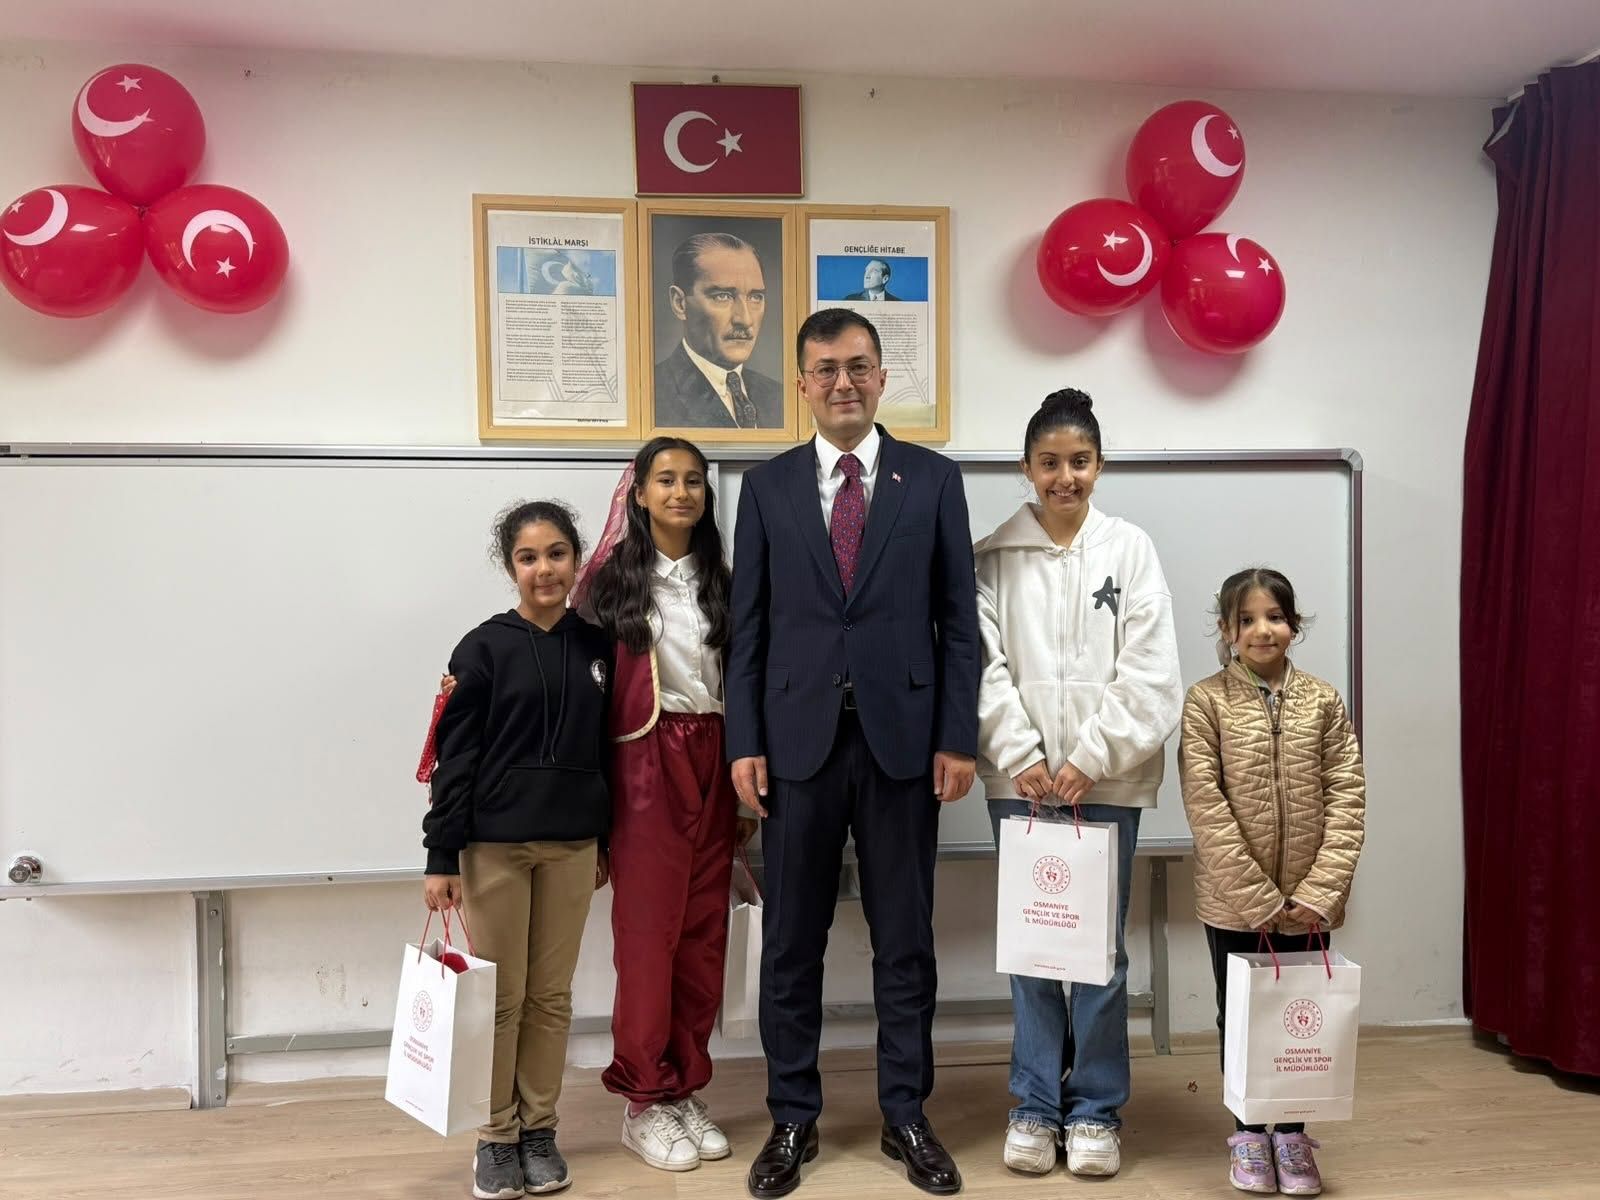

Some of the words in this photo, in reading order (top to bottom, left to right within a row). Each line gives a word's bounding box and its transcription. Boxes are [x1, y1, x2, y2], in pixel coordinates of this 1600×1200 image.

[844, 245, 879, 254] GENÇLİĞE
[880, 245, 905, 254] HİTABE
[1033, 901, 1069, 911] OSMANİYE
[1022, 909, 1050, 917] GENÇLİK
[1051, 911, 1060, 919] VE
[1061, 913, 1080, 921] SPOR
[1025, 916, 1031, 924] İL
[1032, 917, 1077, 929] MÜDÜRLÜĞÜ
[1284, 1047, 1321, 1055] OSMANİYE
[1273, 1056, 1302, 1064] GENÇLİK
[1276, 1064, 1282, 1072] İL
[1283, 1064, 1329, 1072] MÜDÜRLÜĞÜ
